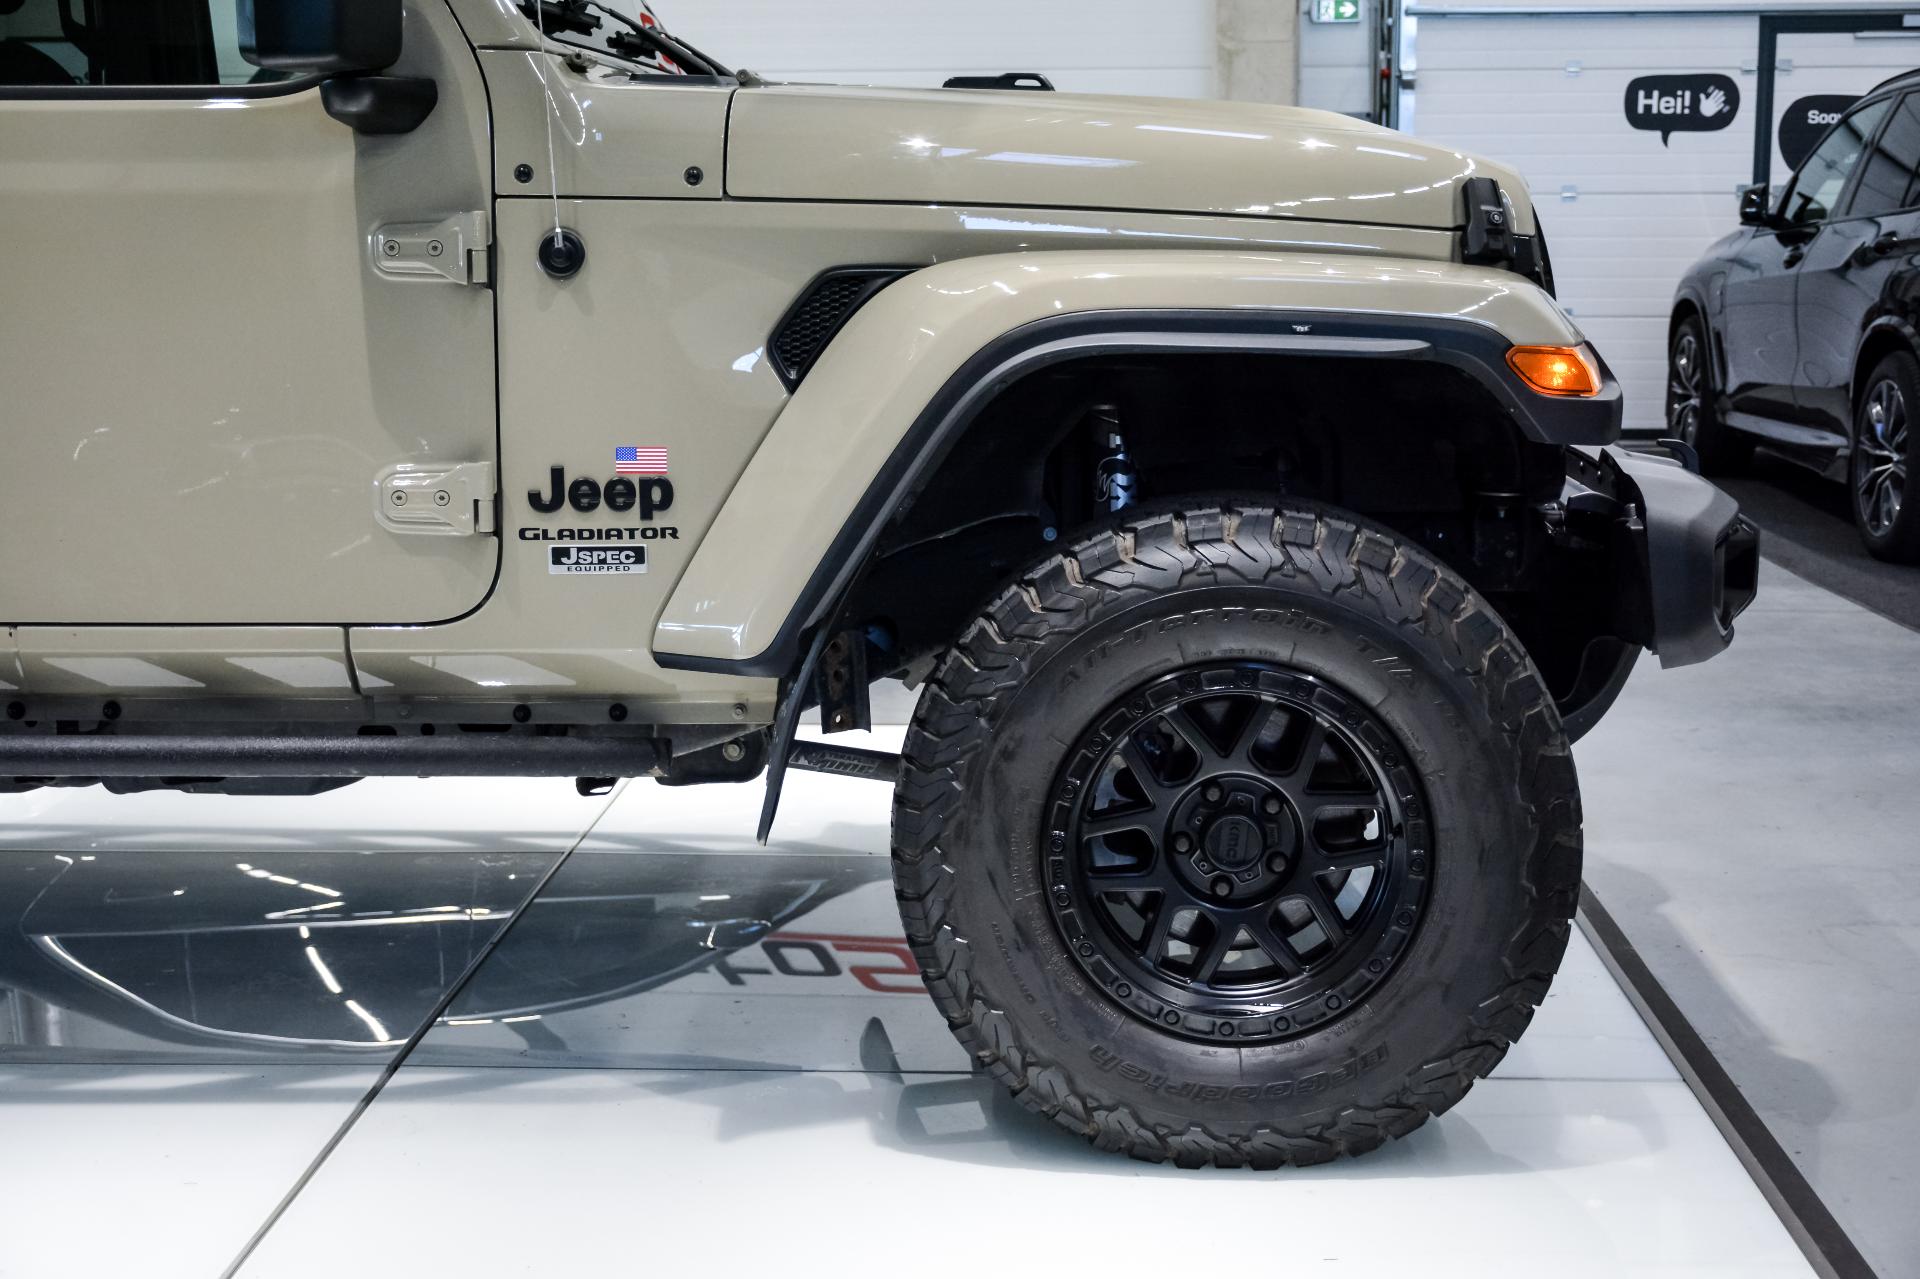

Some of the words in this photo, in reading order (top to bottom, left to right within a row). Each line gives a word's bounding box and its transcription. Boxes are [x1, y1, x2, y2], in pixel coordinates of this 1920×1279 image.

[1637, 89, 1691, 115] Hei!
[527, 465, 674, 521] Jeep
[518, 526, 680, 541] GLADIATOR
[560, 547, 636, 565] JSPEC
